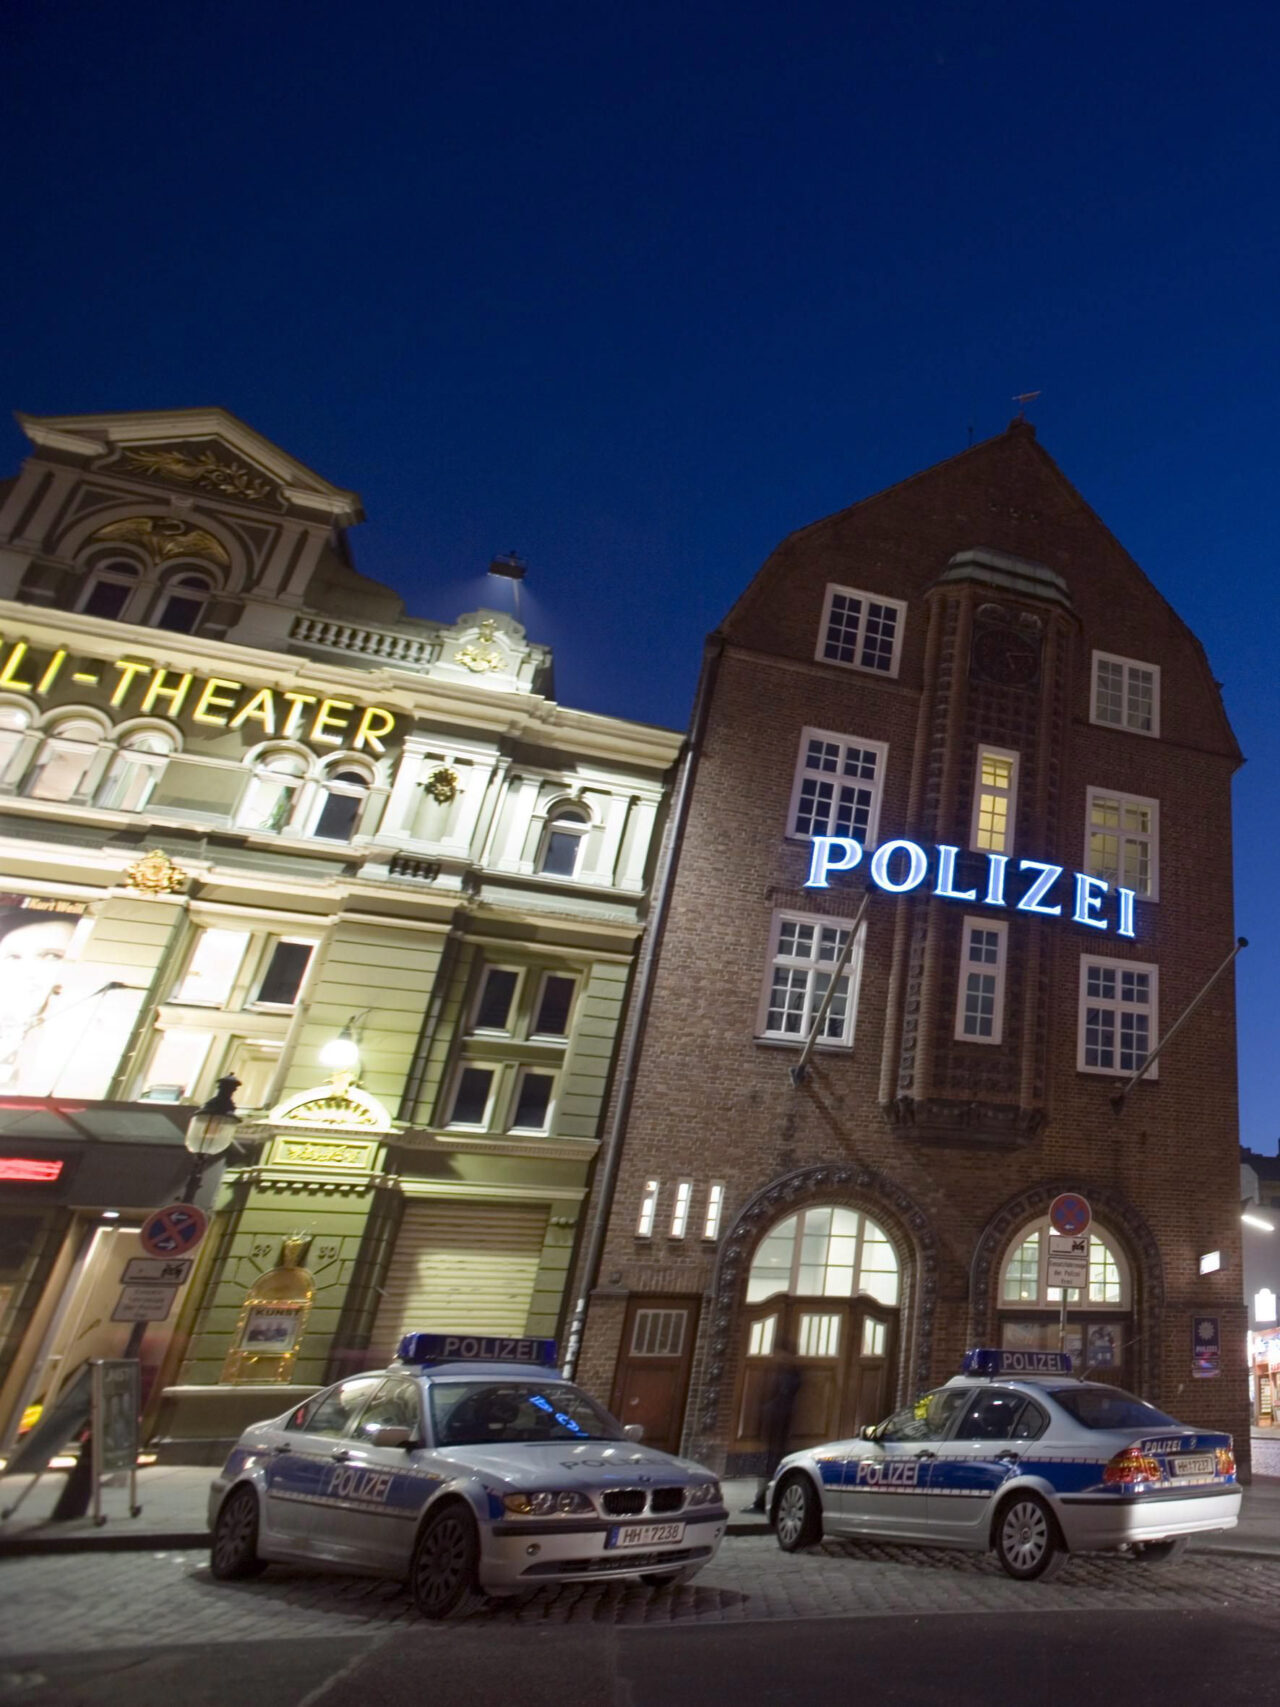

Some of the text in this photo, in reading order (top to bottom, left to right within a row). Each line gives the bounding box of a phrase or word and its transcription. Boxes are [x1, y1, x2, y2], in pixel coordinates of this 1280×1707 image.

[804, 836, 1136, 937] POLIZEI
[443, 1337, 538, 1360] POLIZEI
[1003, 1353, 1062, 1370] POLIZEI
[1144, 1440, 1182, 1454] POLIZEI
[327, 1466, 395, 1503] POLIZEI
[856, 1461, 919, 1486] POLIZEI
[651, 1524, 680, 1541] 7238
